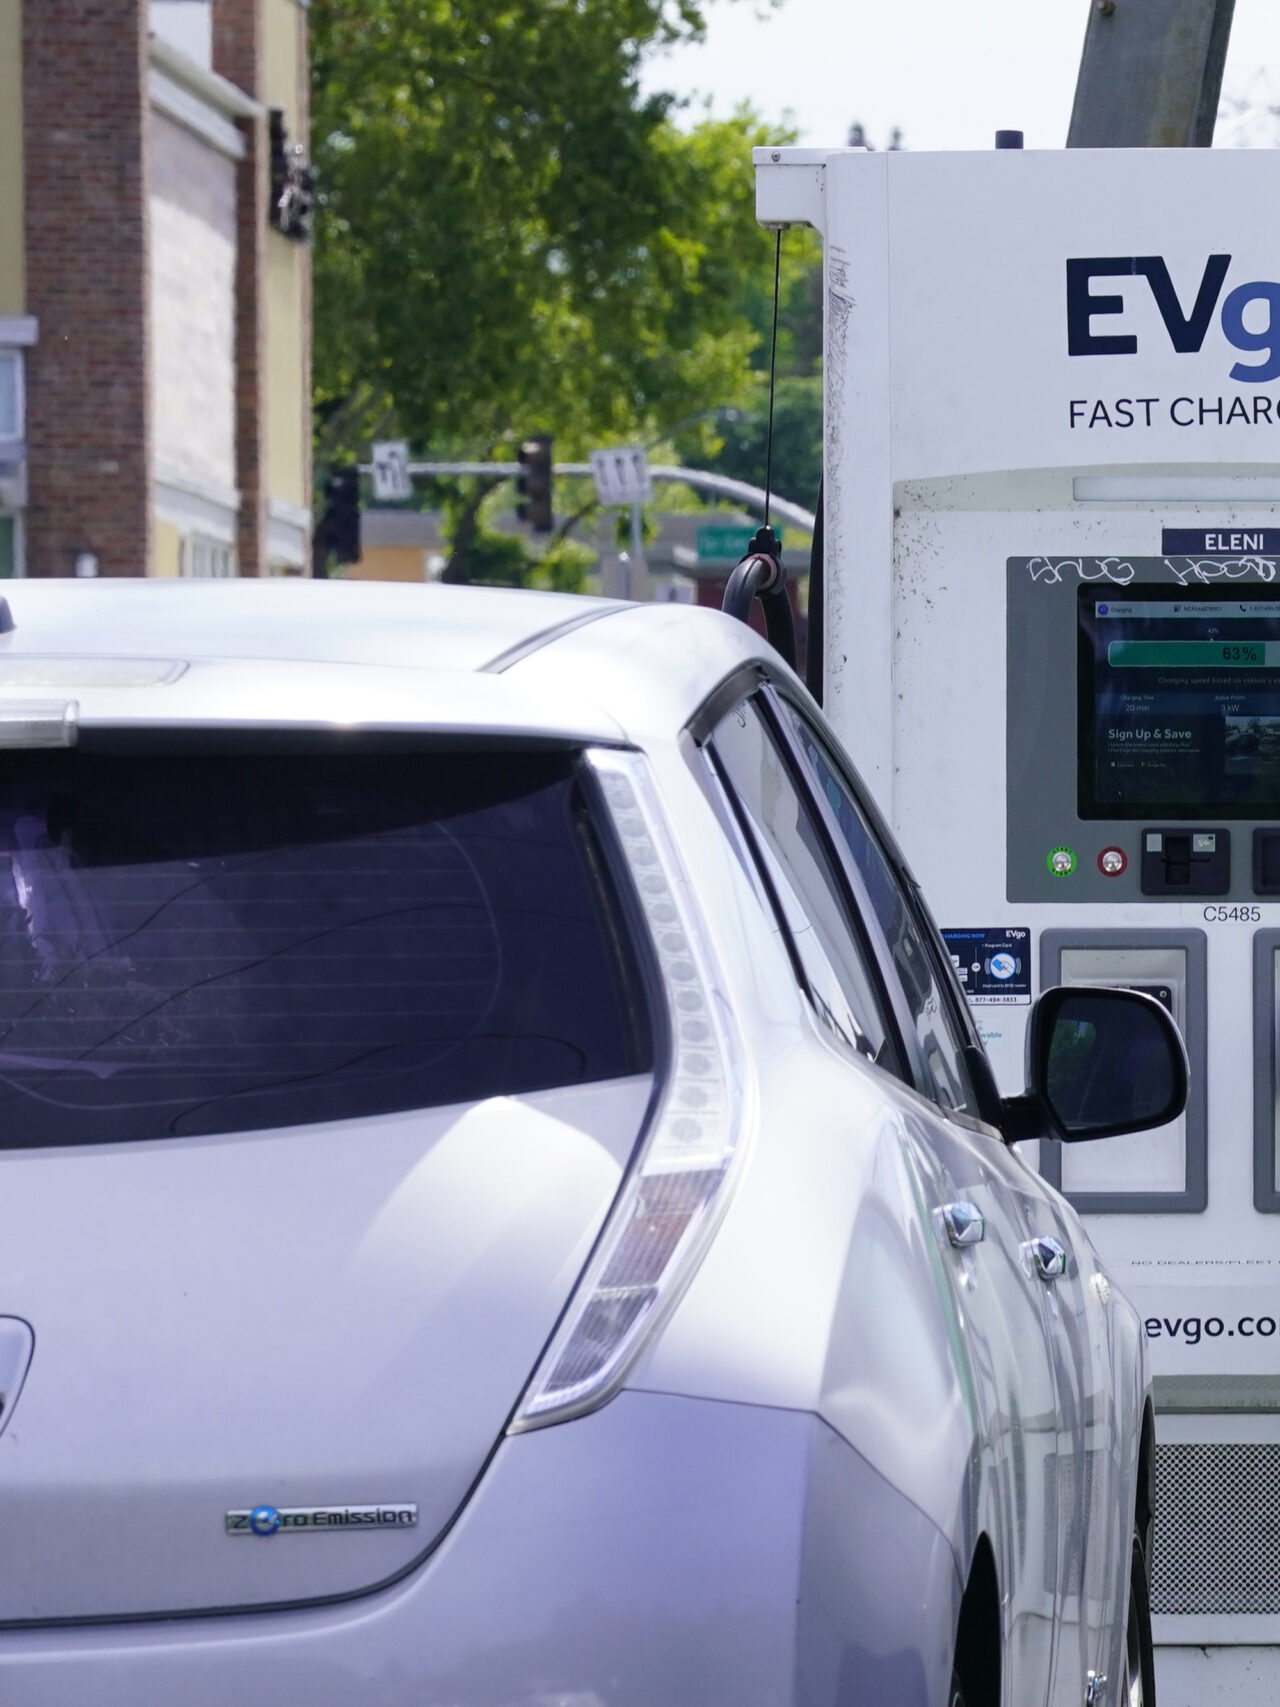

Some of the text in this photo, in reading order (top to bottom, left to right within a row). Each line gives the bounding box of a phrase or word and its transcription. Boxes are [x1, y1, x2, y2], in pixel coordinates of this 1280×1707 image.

[1070, 398, 1159, 428] FAST
[1205, 534, 1264, 551] ELENI
[1222, 646, 1257, 662] 63%
[1158, 677, 1189, 686] Charging
[1190, 677, 1210, 686] speed
[1108, 728, 1192, 742] Sign Up & Save
[1203, 906, 1261, 923] C5485
[1006, 930, 1026, 939] EVgo
[232, 1505, 413, 1537] Zero Emission
